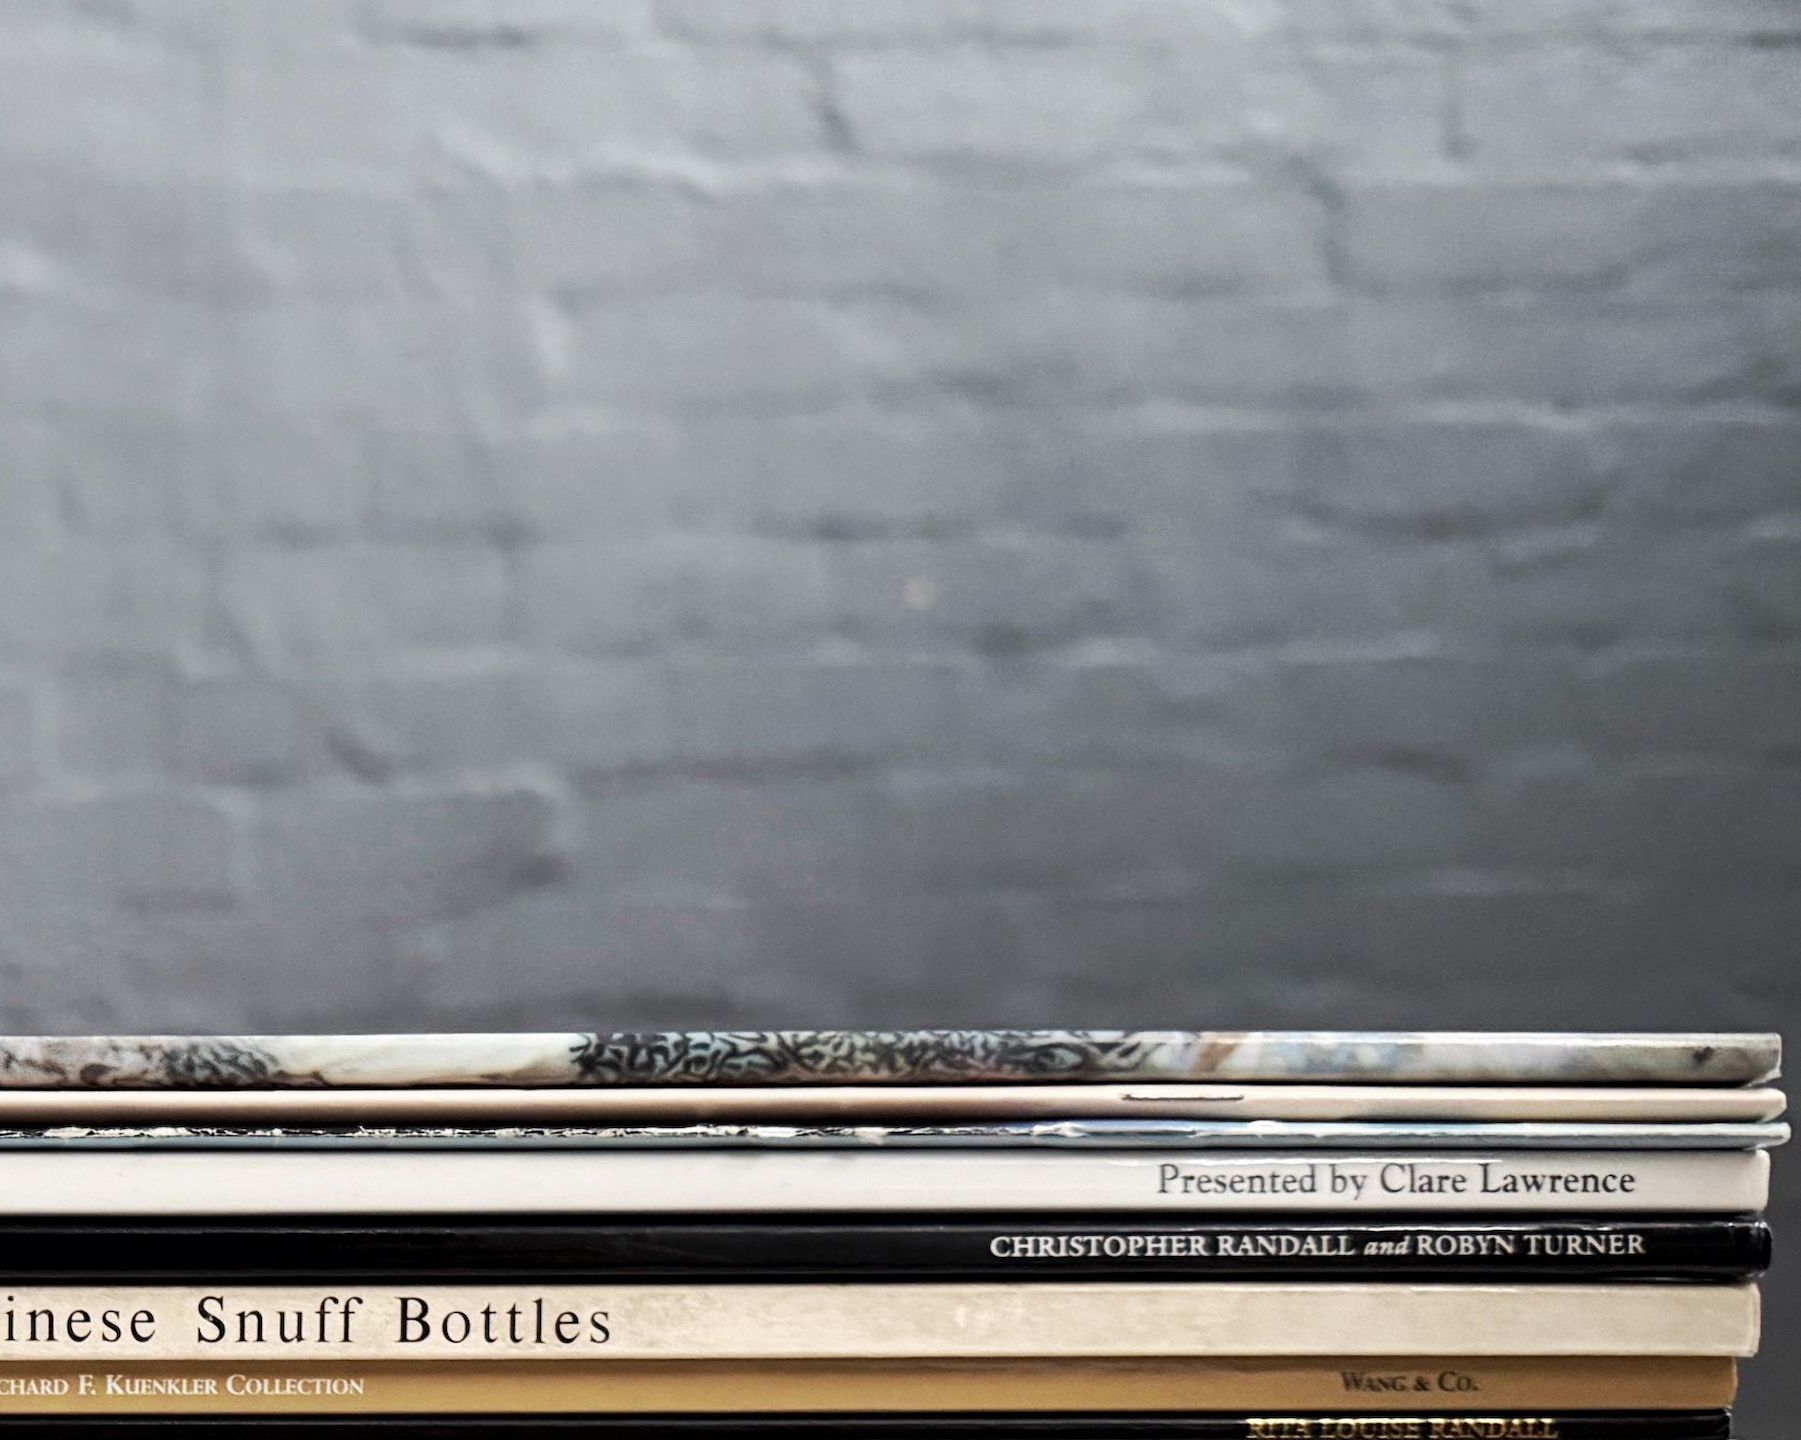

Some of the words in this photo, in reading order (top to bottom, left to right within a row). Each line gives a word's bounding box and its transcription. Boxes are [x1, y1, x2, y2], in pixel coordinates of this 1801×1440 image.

[1159, 1163, 1317, 1194] Presented
[1330, 1163, 1368, 1202] by
[1381, 1162, 1467, 1194] Clare
[1480, 1162, 1636, 1194] Lawrence
[990, 1235, 1209, 1258] CHRISTOPHER
[1216, 1235, 1356, 1258] RANDALL
[1364, 1236, 1411, 1258] and
[1418, 1234, 1516, 1257] ROBYN
[1524, 1234, 1646, 1256] TURNER
[197, 1295, 364, 1344] Snuff
[397, 1296, 611, 1345] Bottles
[1413, 1371, 1431, 1392] &
[1245, 1417, 1312, 1440] RITA
[1320, 1417, 1422, 1440] LOUISE
[1427, 1417, 1560, 1440] RANDALL
